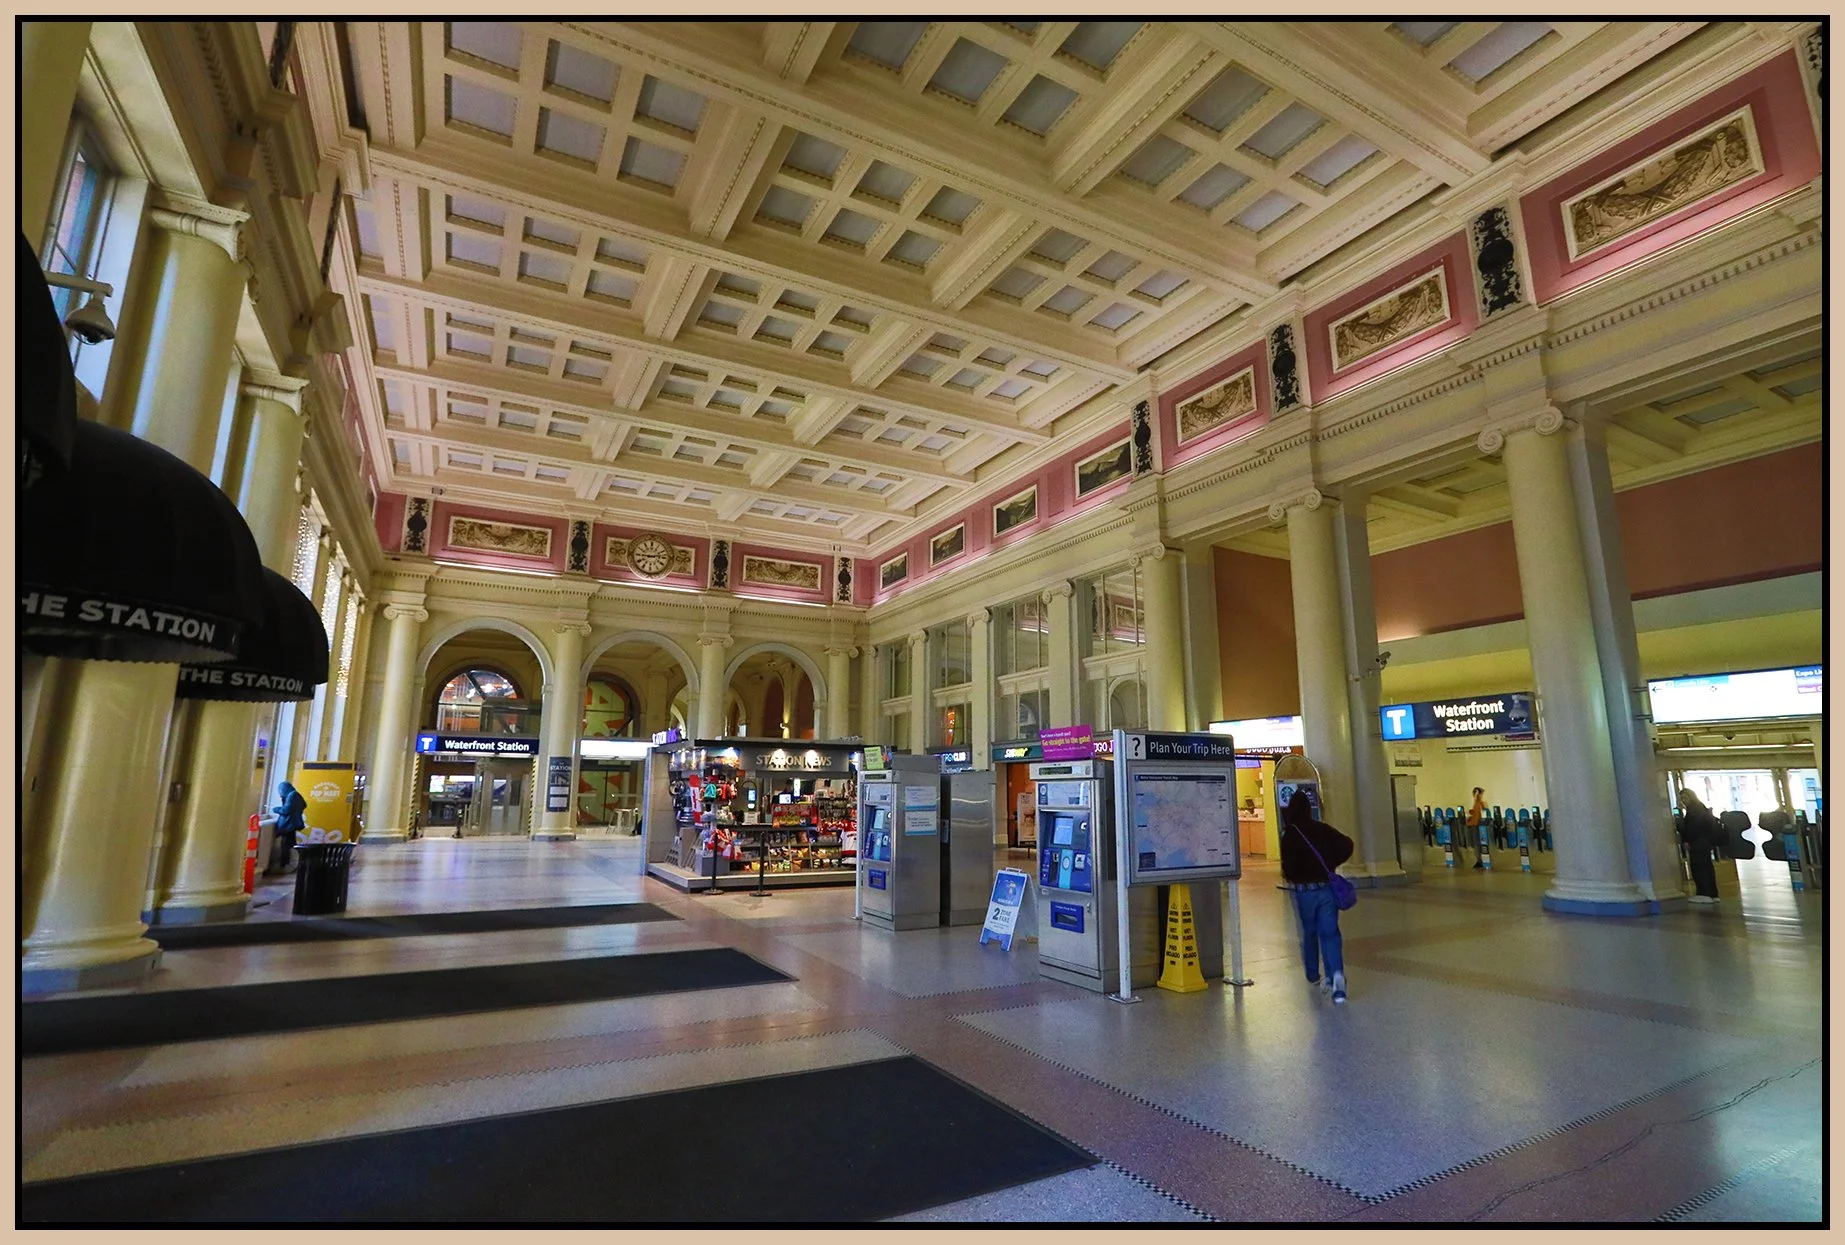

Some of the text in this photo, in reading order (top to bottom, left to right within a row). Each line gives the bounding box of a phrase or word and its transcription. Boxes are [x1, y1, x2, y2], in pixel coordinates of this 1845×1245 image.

[78, 600, 216, 643] STATION
[180, 667, 304, 693] THE STATION
[1433, 700, 1505, 718] Waterfront
[1445, 717, 1494, 732] Station
[444, 740, 495, 750] Waterfront
[497, 741, 529, 751] Station
[1150, 742, 1170, 753] Plan
[1172, 742, 1191, 754] Your
[1192, 743, 1209, 756] Trip
[1210, 744, 1230, 755] Here
[756, 755, 802, 765] STAON
[992, 908, 1000, 920] 2
